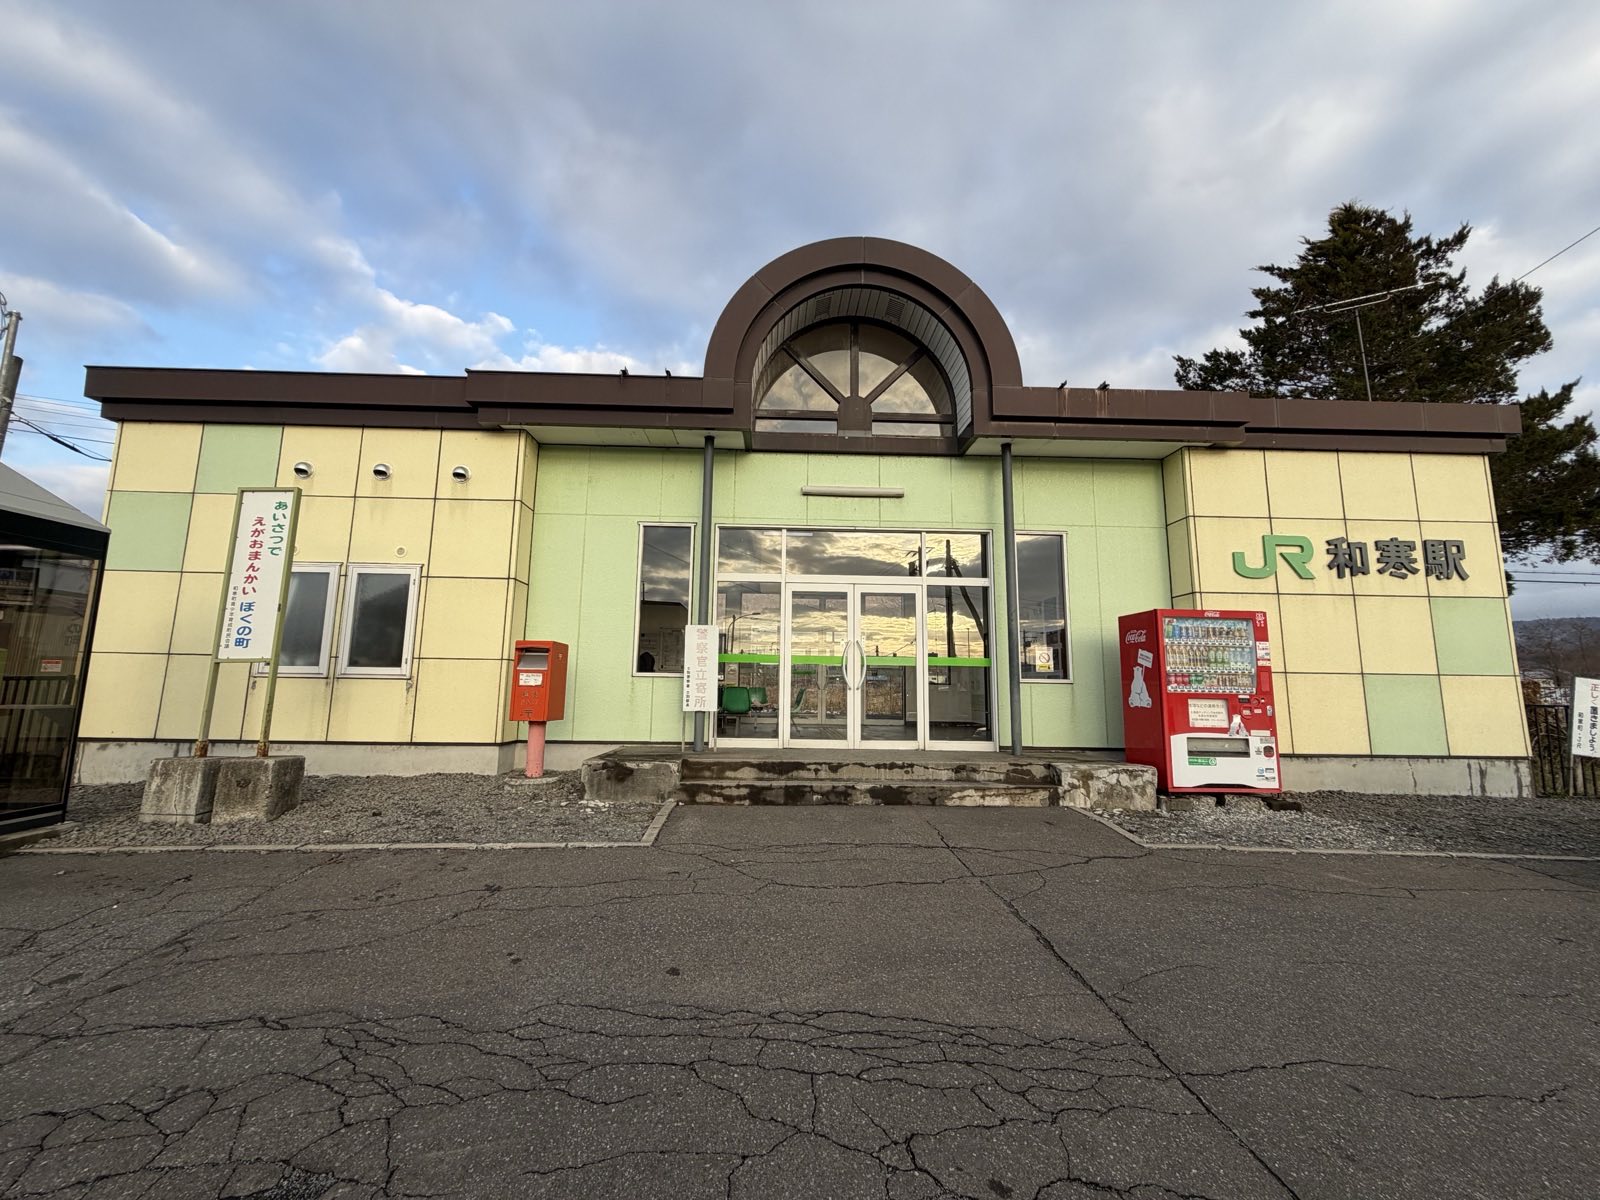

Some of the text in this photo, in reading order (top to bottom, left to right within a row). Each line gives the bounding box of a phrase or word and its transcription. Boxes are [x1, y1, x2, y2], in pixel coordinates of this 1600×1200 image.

[267, 500, 289, 556] あいさつで
[1232, 534, 1470, 581] JR 和寒駅
[694, 628, 708, 708] 警察官立寄所
